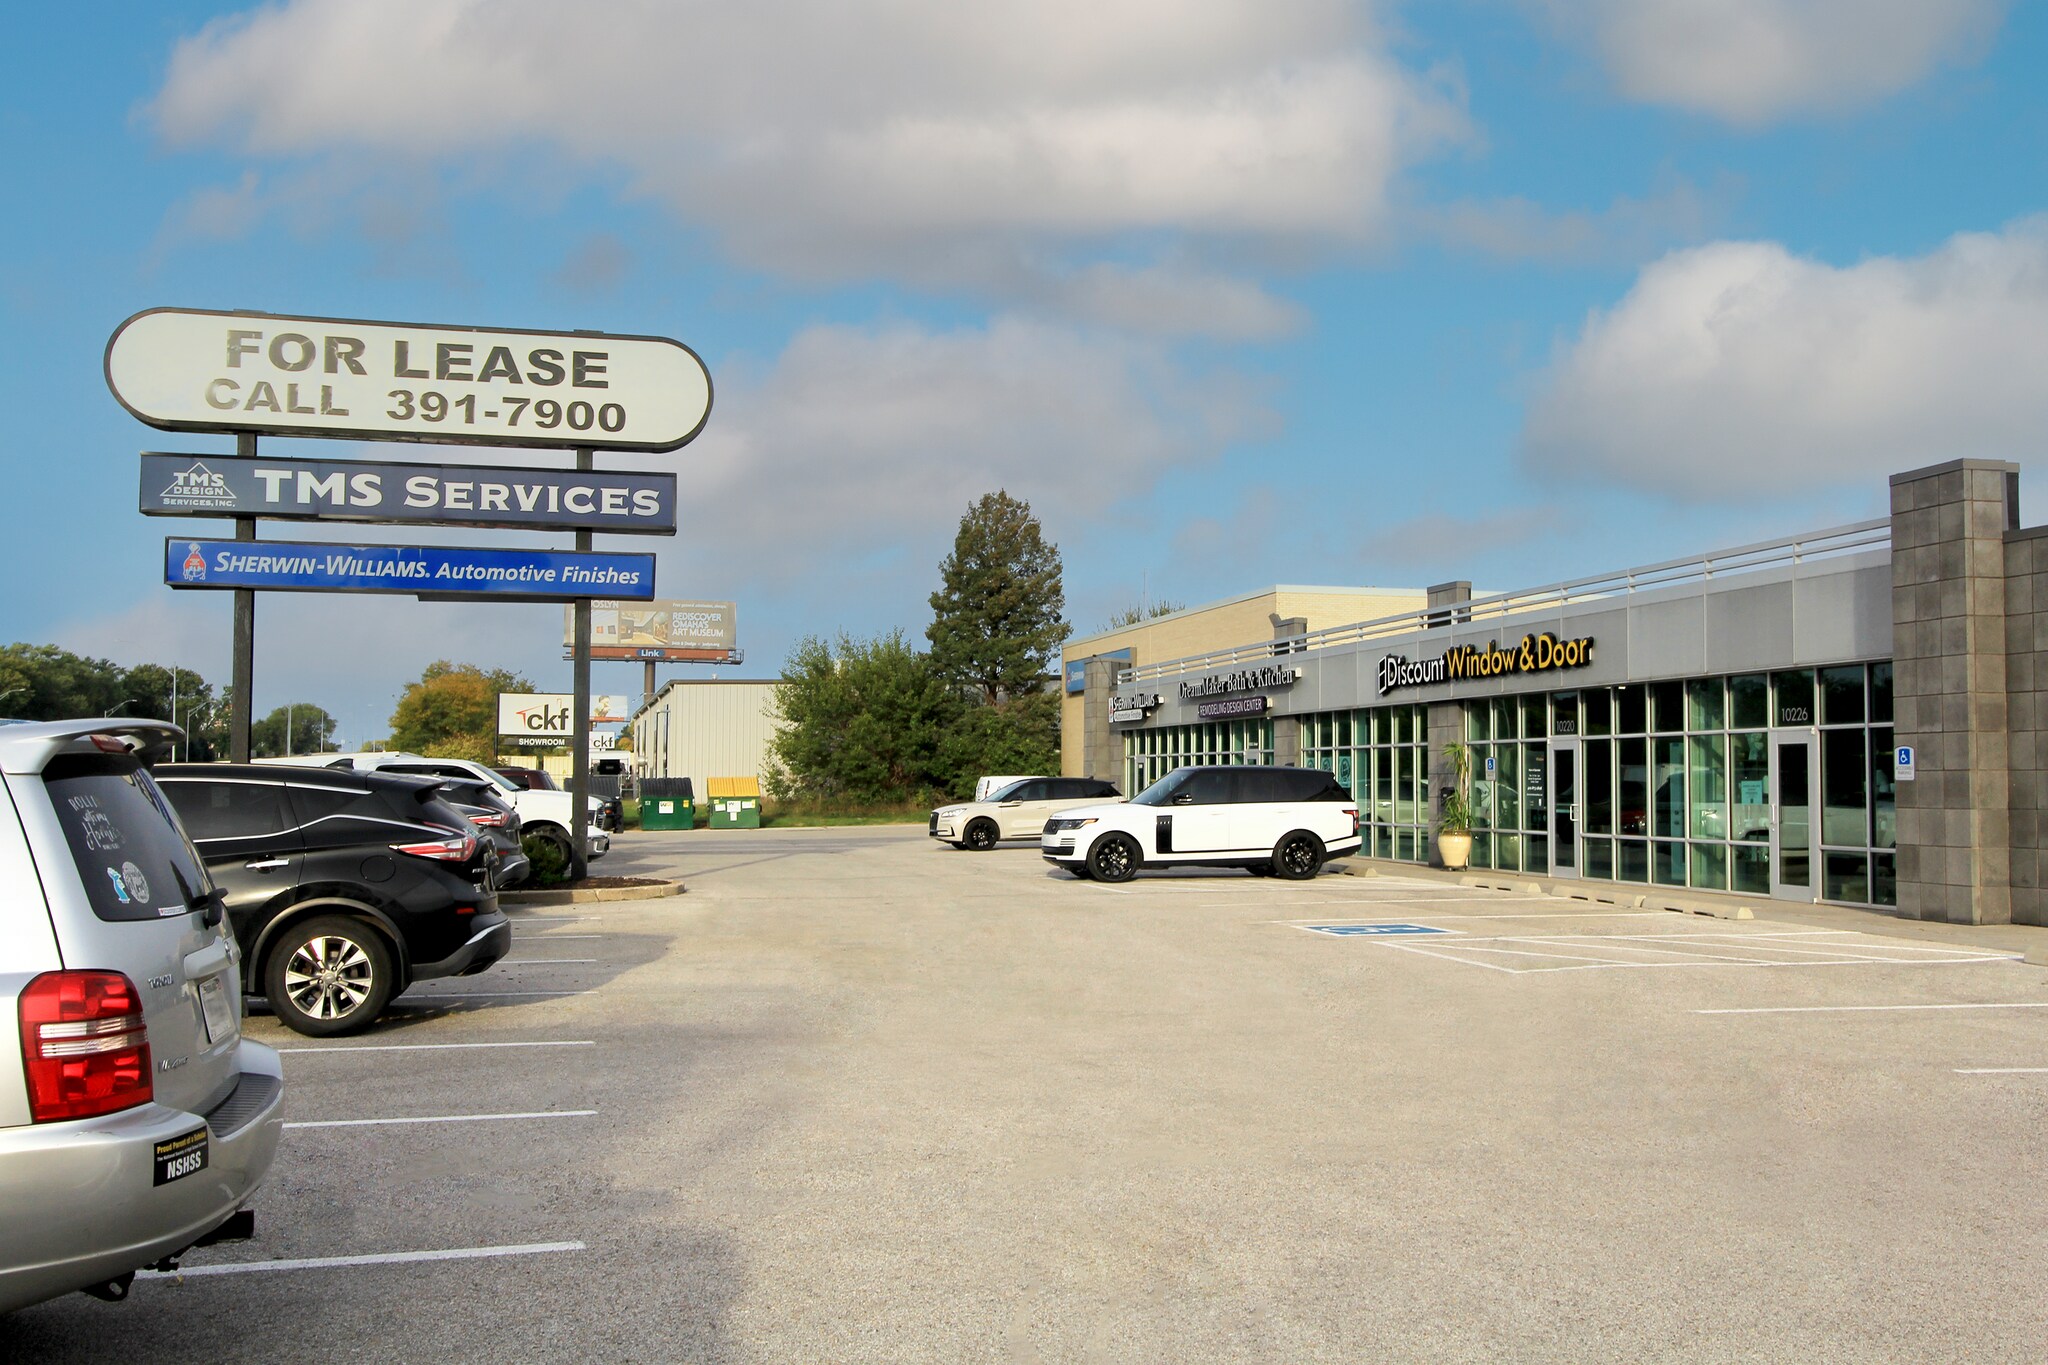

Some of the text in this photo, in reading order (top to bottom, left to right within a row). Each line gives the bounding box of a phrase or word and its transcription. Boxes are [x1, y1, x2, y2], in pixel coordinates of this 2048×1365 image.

[226, 329, 609, 388] FOR LEASE
[205, 378, 627, 432] CALL 391-7900
[173, 472, 224, 487] TMS
[173, 486, 224, 496] DESIGN
[254, 469, 660, 516] TMS SERVICES
[163, 498, 236, 508] SERVICES, INC.
[435, 561, 556, 582] Automotive
[562, 566, 640, 584] Finishes
[672, 612, 722, 621] REDISCOVER
[672, 629, 724, 637] ART MUSEUM
[1387, 634, 1588, 686] Discount Window & Door
[1227, 671, 1246, 692] Bath
[1248, 674, 1255, 688] &
[1258, 667, 1293, 687] Kitchen
[1200, 698, 1262, 716] REMODELING DESIGN CENTER
[1781, 707, 1809, 722] 10226
[527, 704, 569, 730] ckf
[1556, 720, 1575, 732] 10220
[518, 738, 566, 746] SHOWROOM
[593, 735, 613, 748] ckf
[167, 1151, 202, 1179] NSHSS
